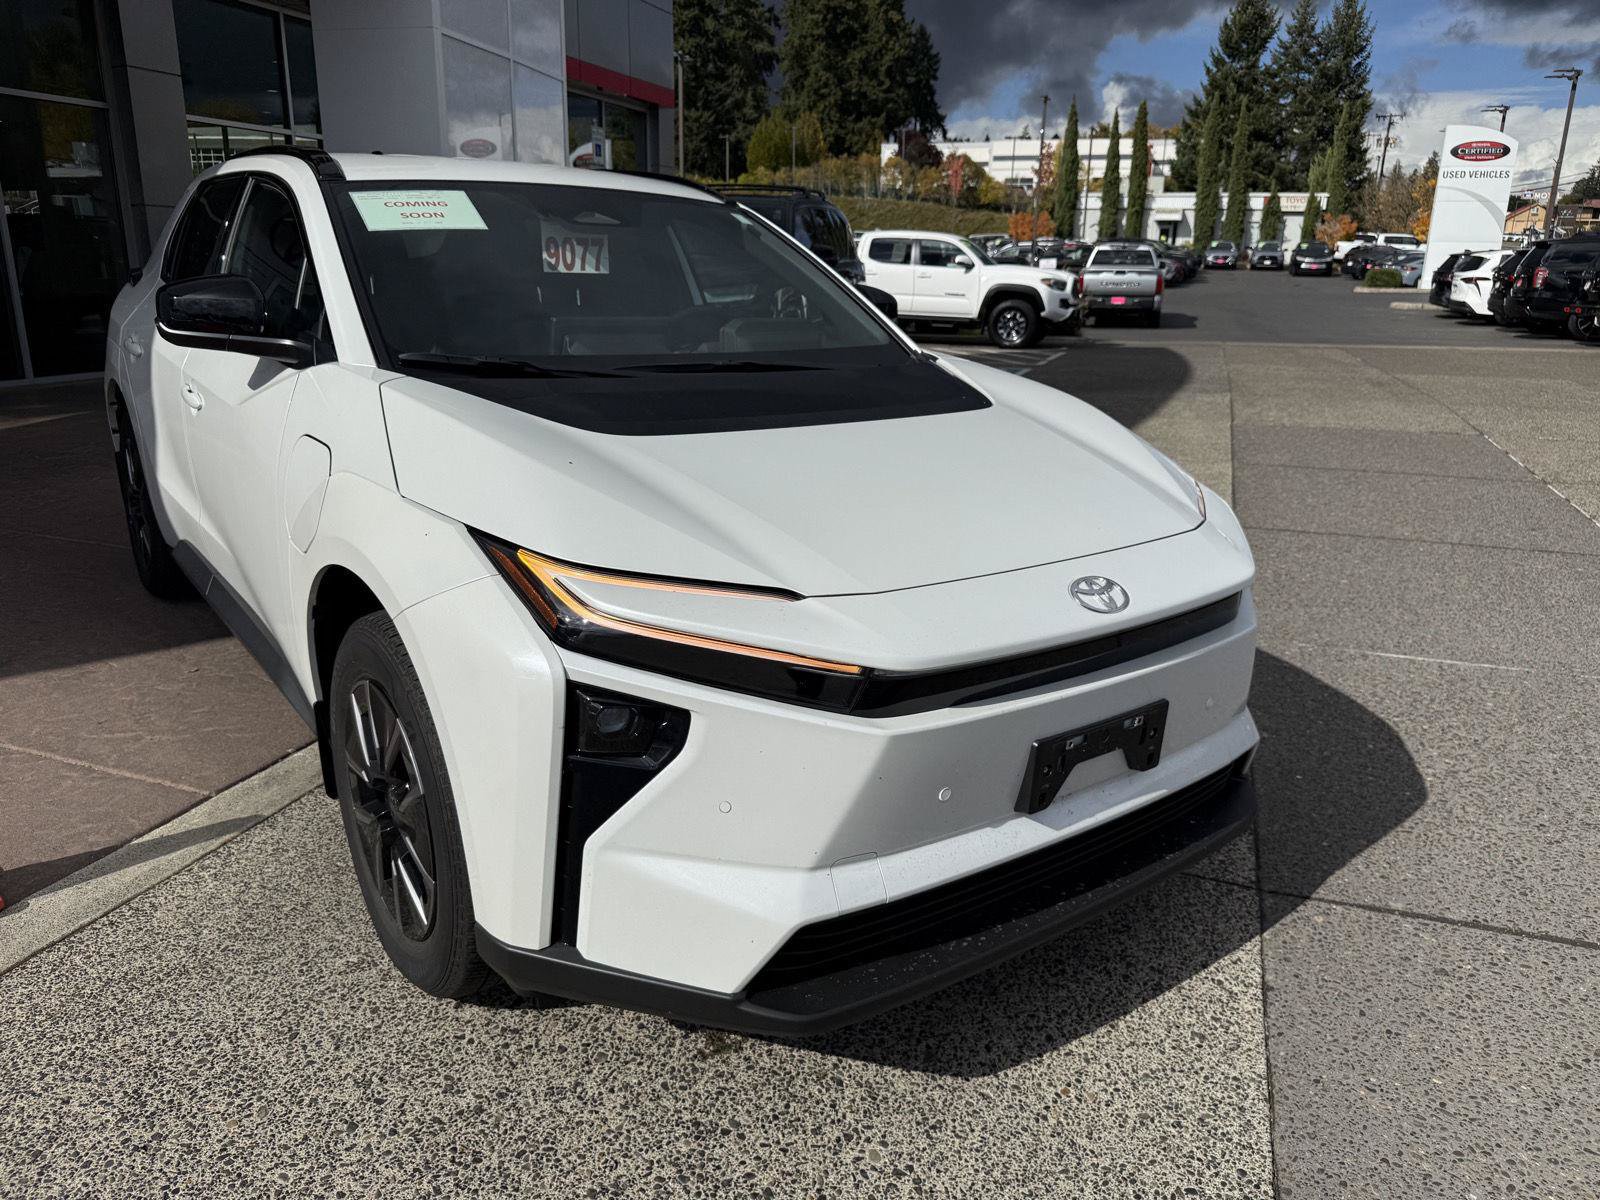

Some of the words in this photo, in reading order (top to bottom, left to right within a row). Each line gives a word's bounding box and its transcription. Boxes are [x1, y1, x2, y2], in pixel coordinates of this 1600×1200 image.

[1442, 170, 1466, 179] USED
[1468, 170, 1511, 179] VEHICLES
[545, 235, 605, 272] 9077
